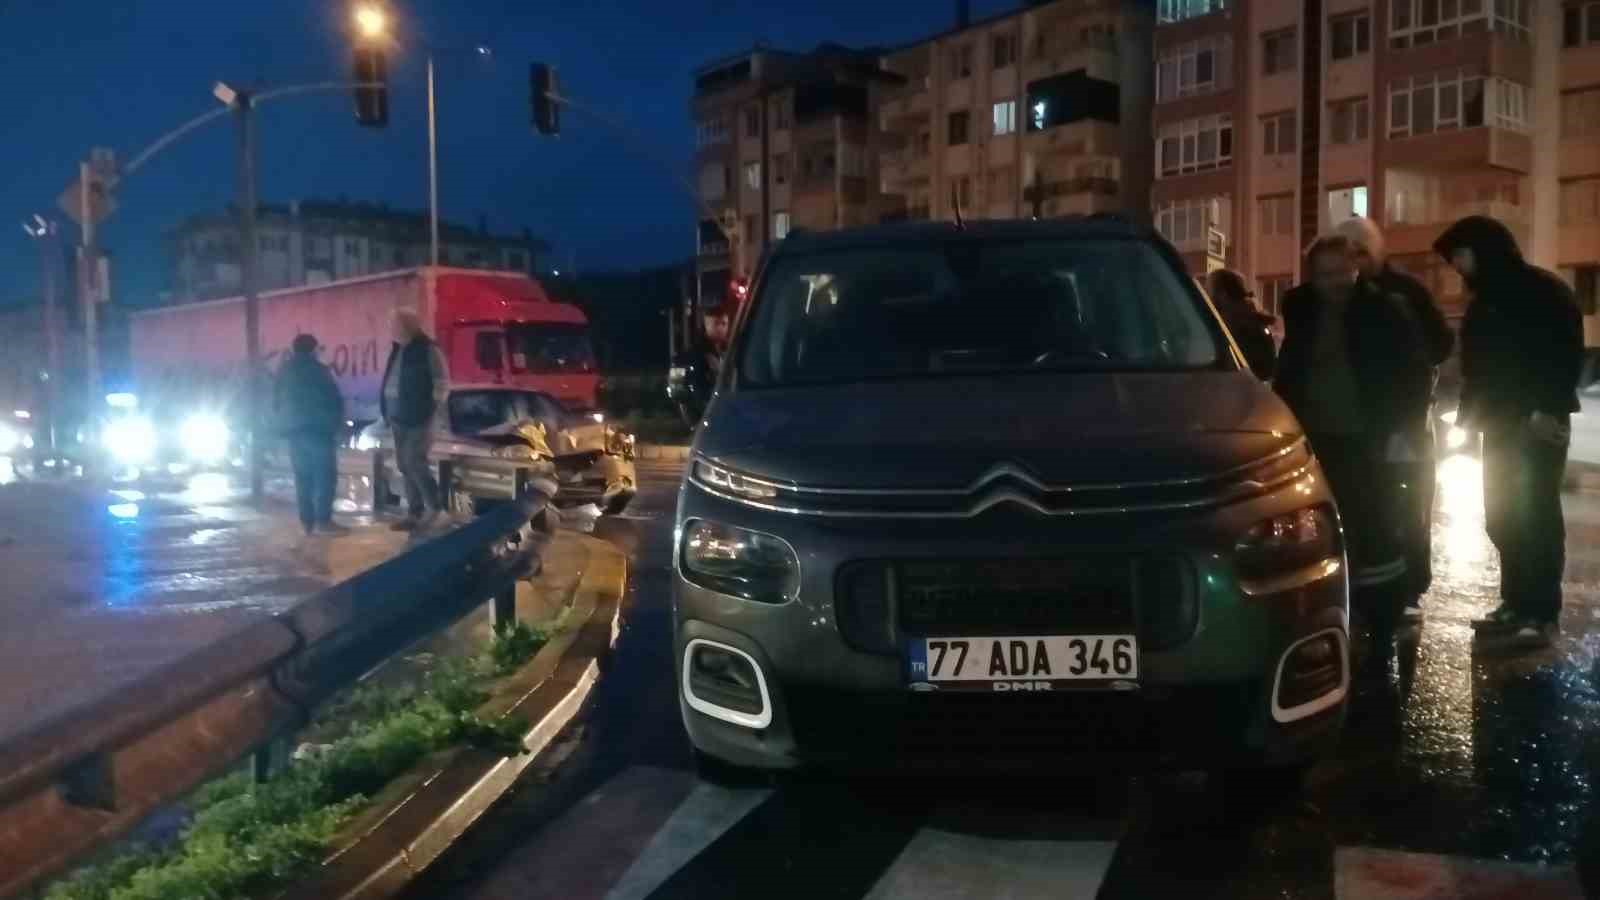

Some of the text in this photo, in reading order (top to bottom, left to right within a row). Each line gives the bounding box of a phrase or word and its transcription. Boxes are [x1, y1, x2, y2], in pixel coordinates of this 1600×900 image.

[929, 638, 1132, 677] 77 ADA 346
[911, 661, 927, 672] TR
[993, 681, 1053, 692] DMR
